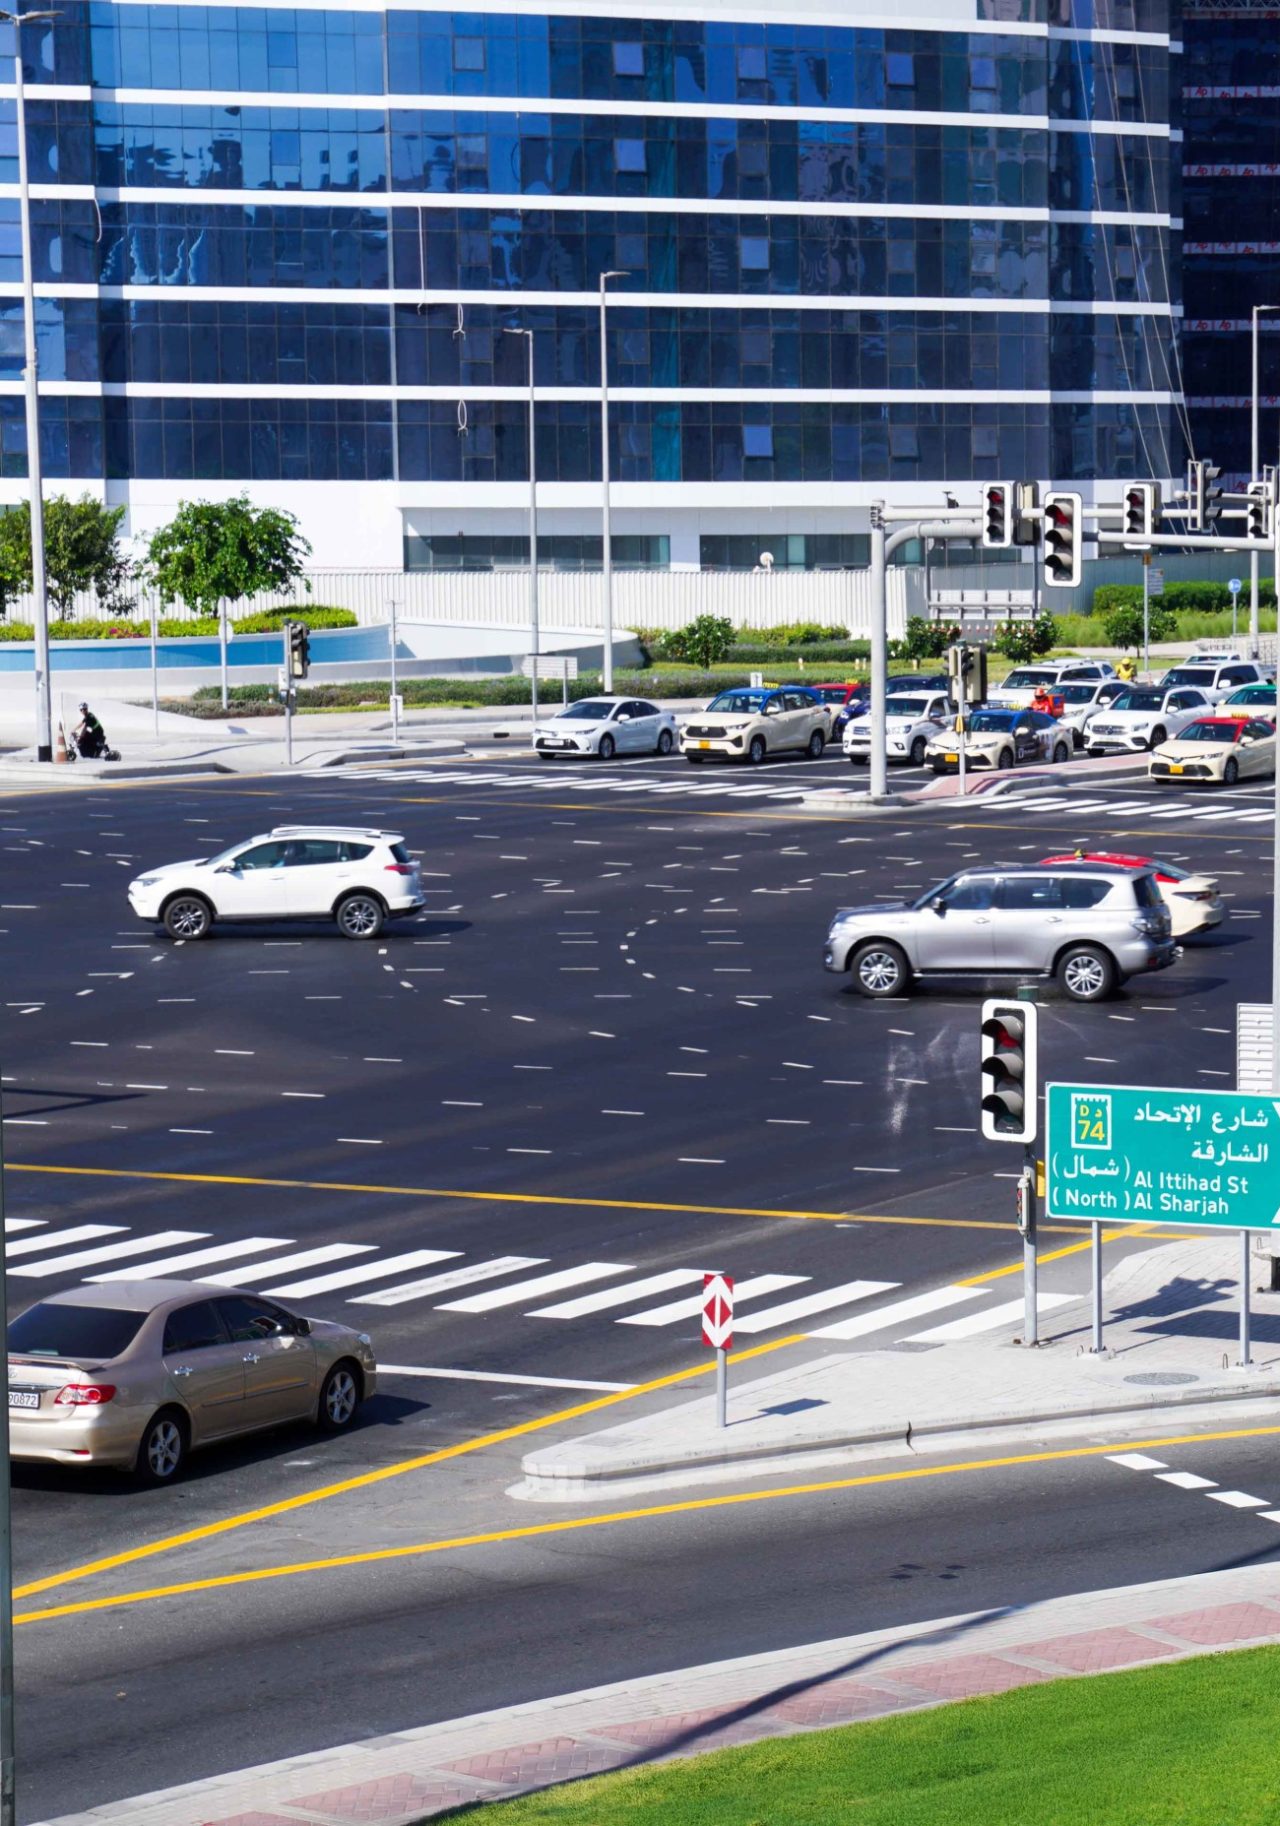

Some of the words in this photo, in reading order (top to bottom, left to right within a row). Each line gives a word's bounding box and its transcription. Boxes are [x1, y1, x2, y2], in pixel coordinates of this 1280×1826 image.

[1079, 1104, 1090, 1117] D
[1133, 1101, 1201, 1132] الإتحاد
[1211, 1106, 1269, 1134] شارع
[1078, 1119, 1105, 1141] 74
[1191, 1139, 1269, 1167] الشارقة
[1133, 1170, 1153, 1189] Al
[1159, 1171, 1221, 1192] Ittihad
[1227, 1175, 1249, 1194] St
[1133, 1191, 1153, 1210] Al
[1159, 1192, 1229, 1216] Sharjah
